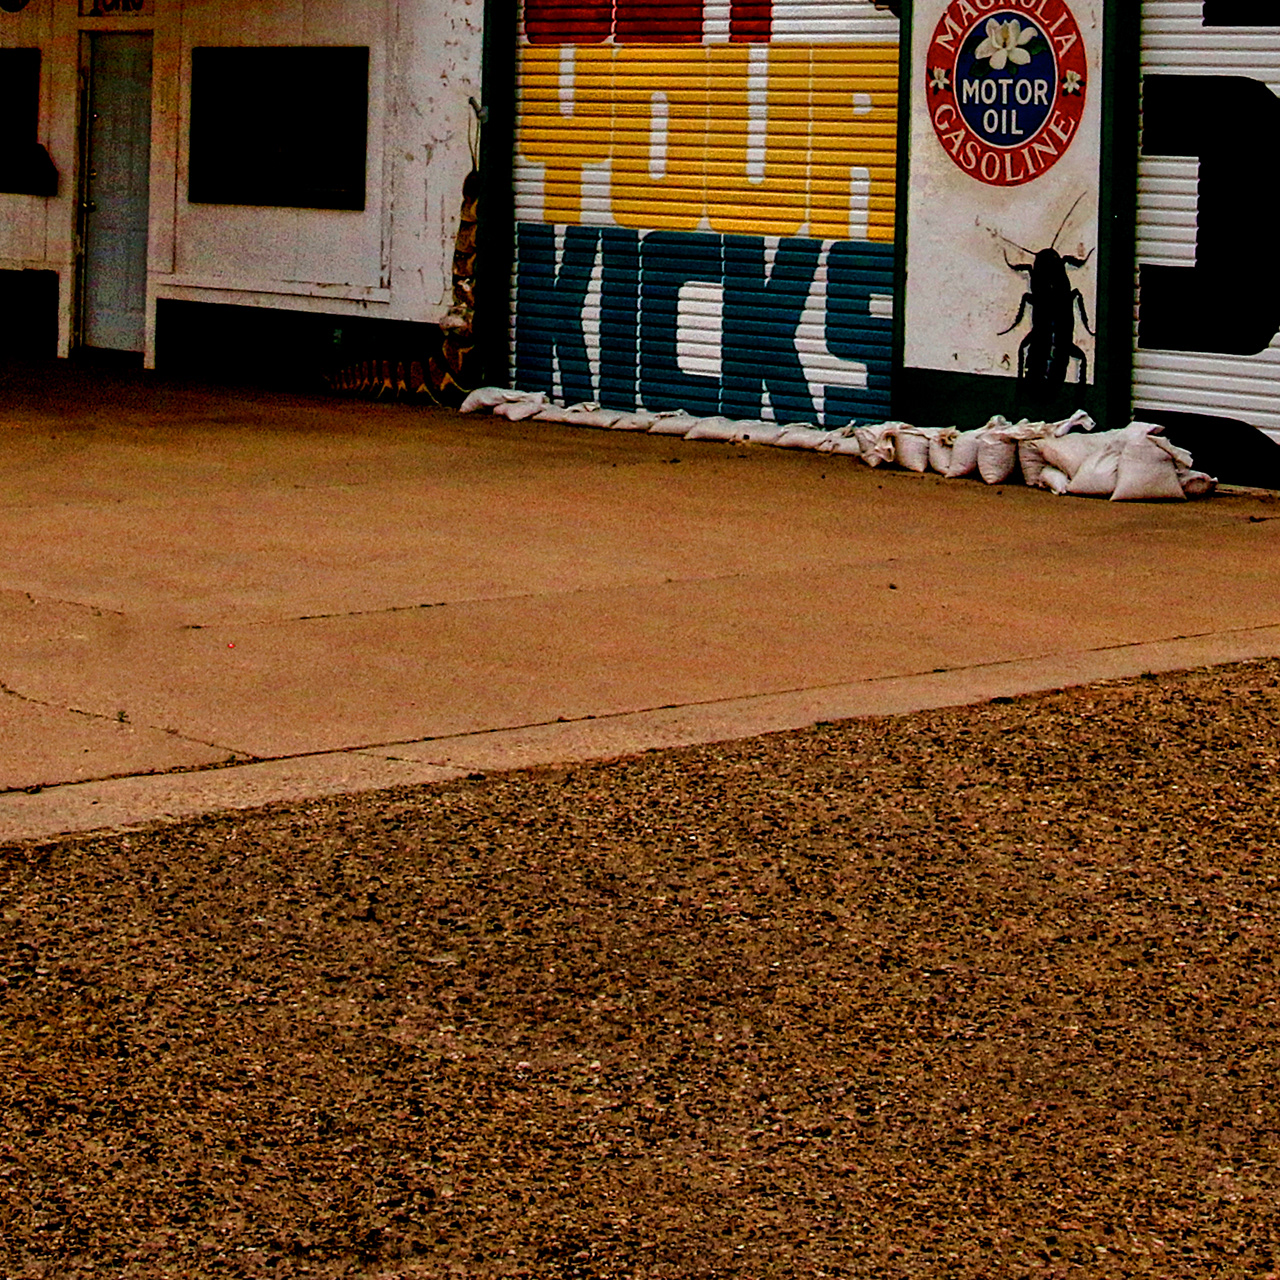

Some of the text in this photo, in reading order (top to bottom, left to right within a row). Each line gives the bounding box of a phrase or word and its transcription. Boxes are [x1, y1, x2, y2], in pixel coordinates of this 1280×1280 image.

[962, 78, 1048, 106] MOTOR
[983, 109, 1024, 135] OIL
[517, 41, 899, 244] YOUR
[934, 103, 1076, 182] GASOLINE
[514, 223, 894, 428] KICKS
